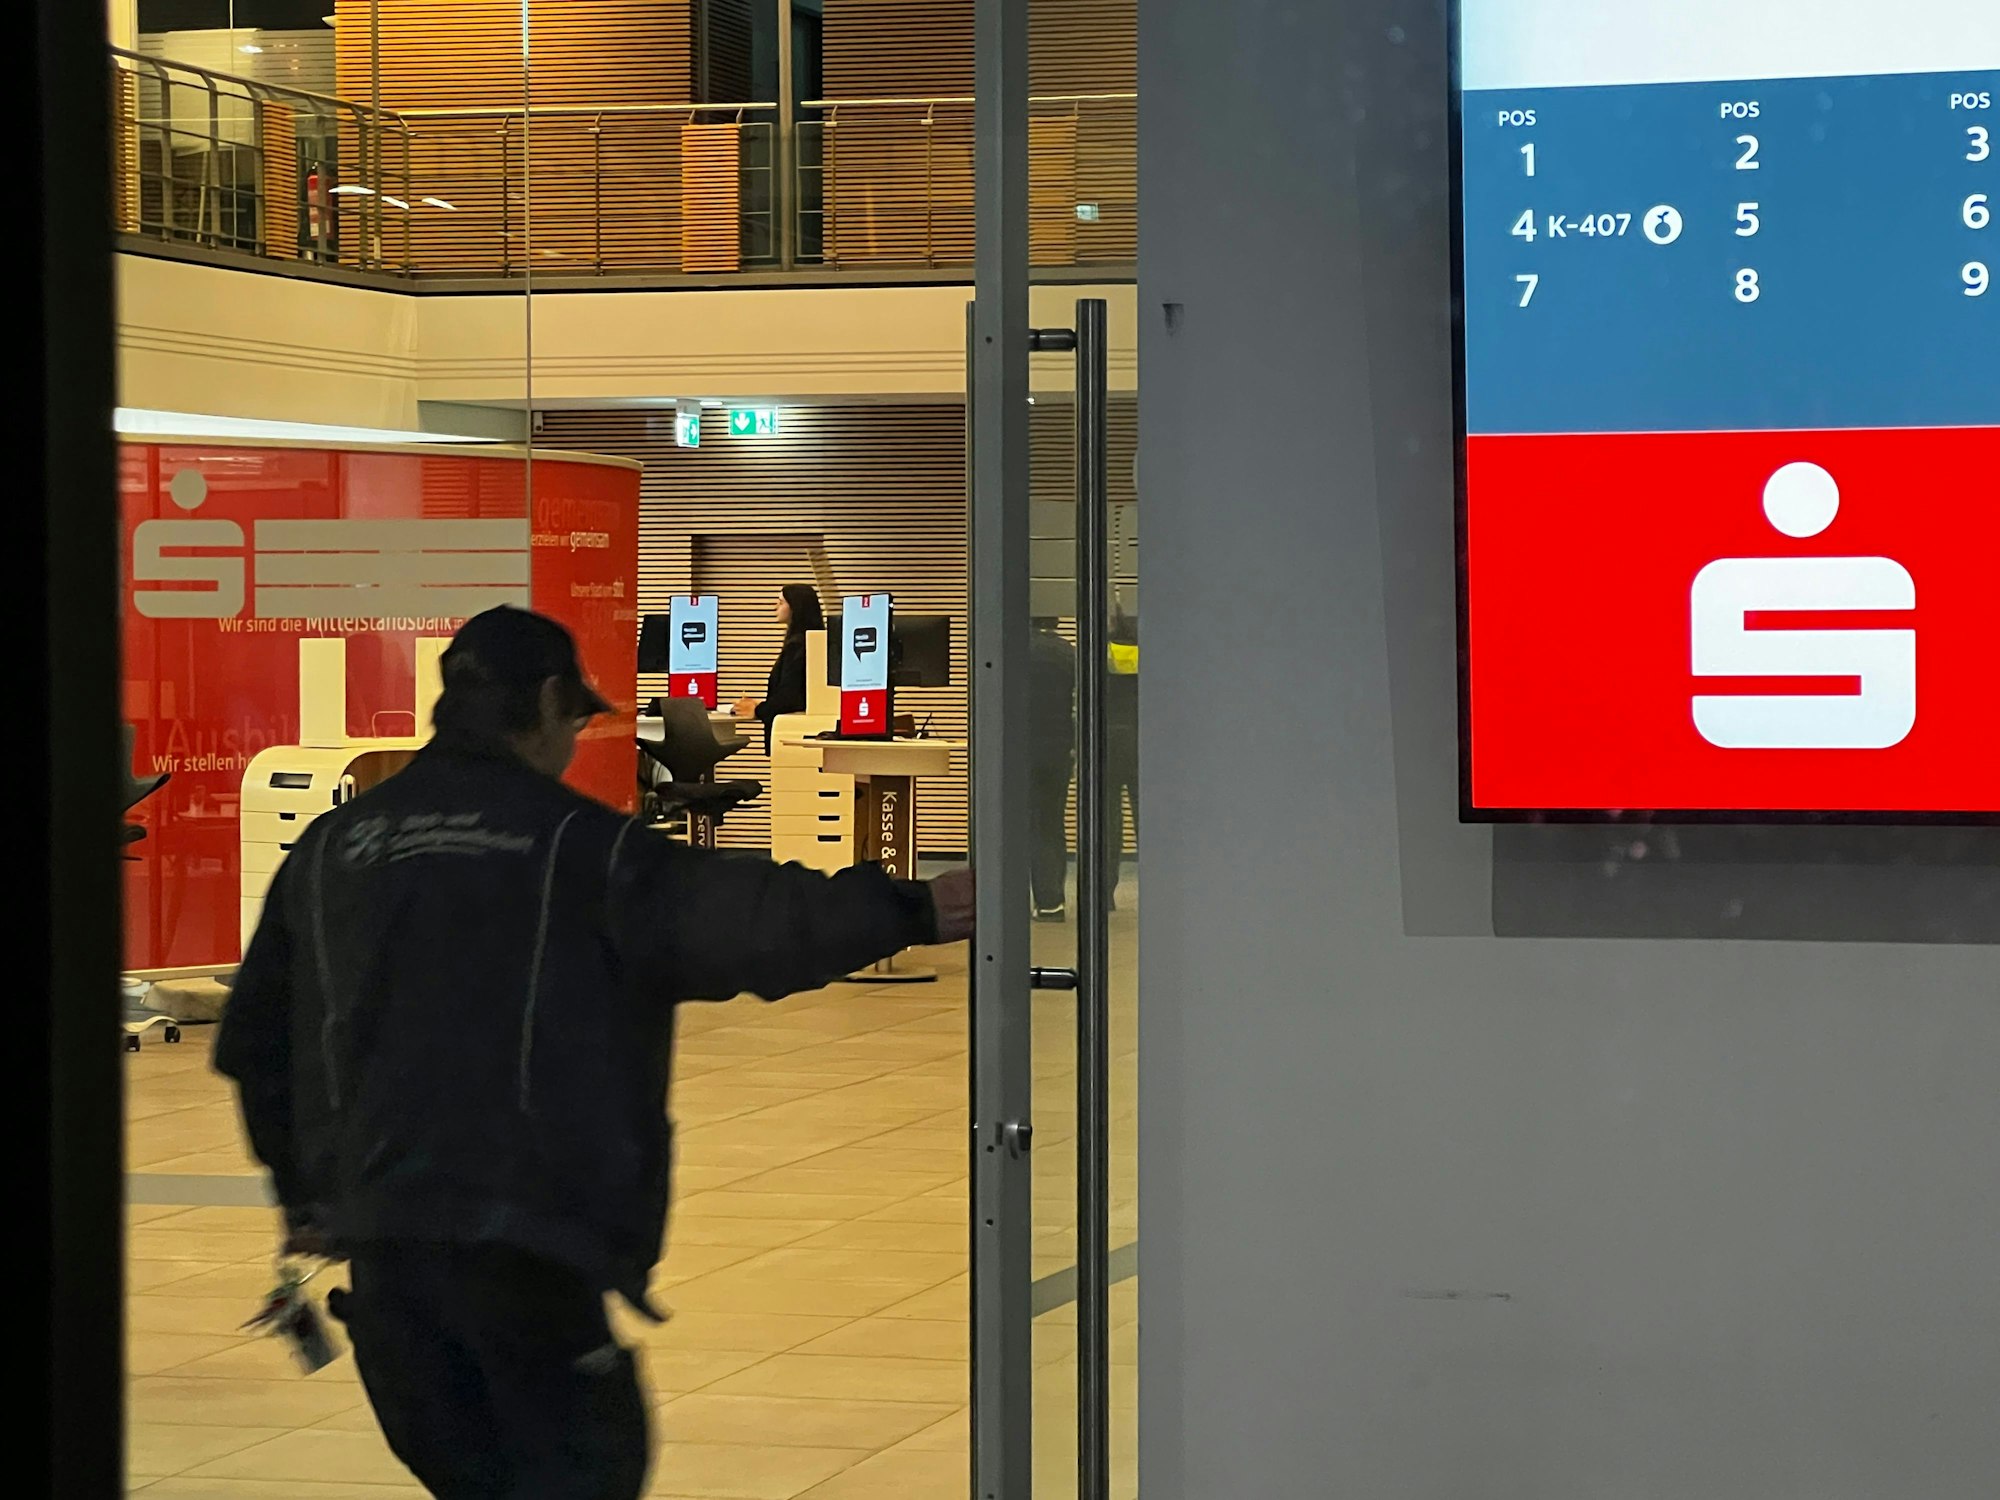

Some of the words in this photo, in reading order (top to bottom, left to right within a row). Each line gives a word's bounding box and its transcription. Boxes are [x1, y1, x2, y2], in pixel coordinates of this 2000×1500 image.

[1720, 101, 1760, 119] POS
[1950, 92, 1991, 110] POS
[1498, 109, 1536, 127] POS
[1519, 143, 1535, 177] 1
[1735, 135, 1760, 170] 2
[1966, 126, 1990, 162] 3
[1511, 209, 1537, 242] 4
[1547, 213, 1632, 239] K-407
[1735, 202, 1760, 237] 5
[1962, 193, 1990, 229] 6
[1516, 274, 1539, 307] 7
[1734, 268, 1760, 303] 8
[1961, 261, 1989, 297] 9
[218, 617, 243, 633] Wir
[246, 617, 277, 632] sind
[281, 617, 302, 632] die
[152, 755, 180, 772] Wir
[184, 753, 234, 772] stellen
[881, 791, 897, 842] Kasse
[881, 846, 897, 859] &
